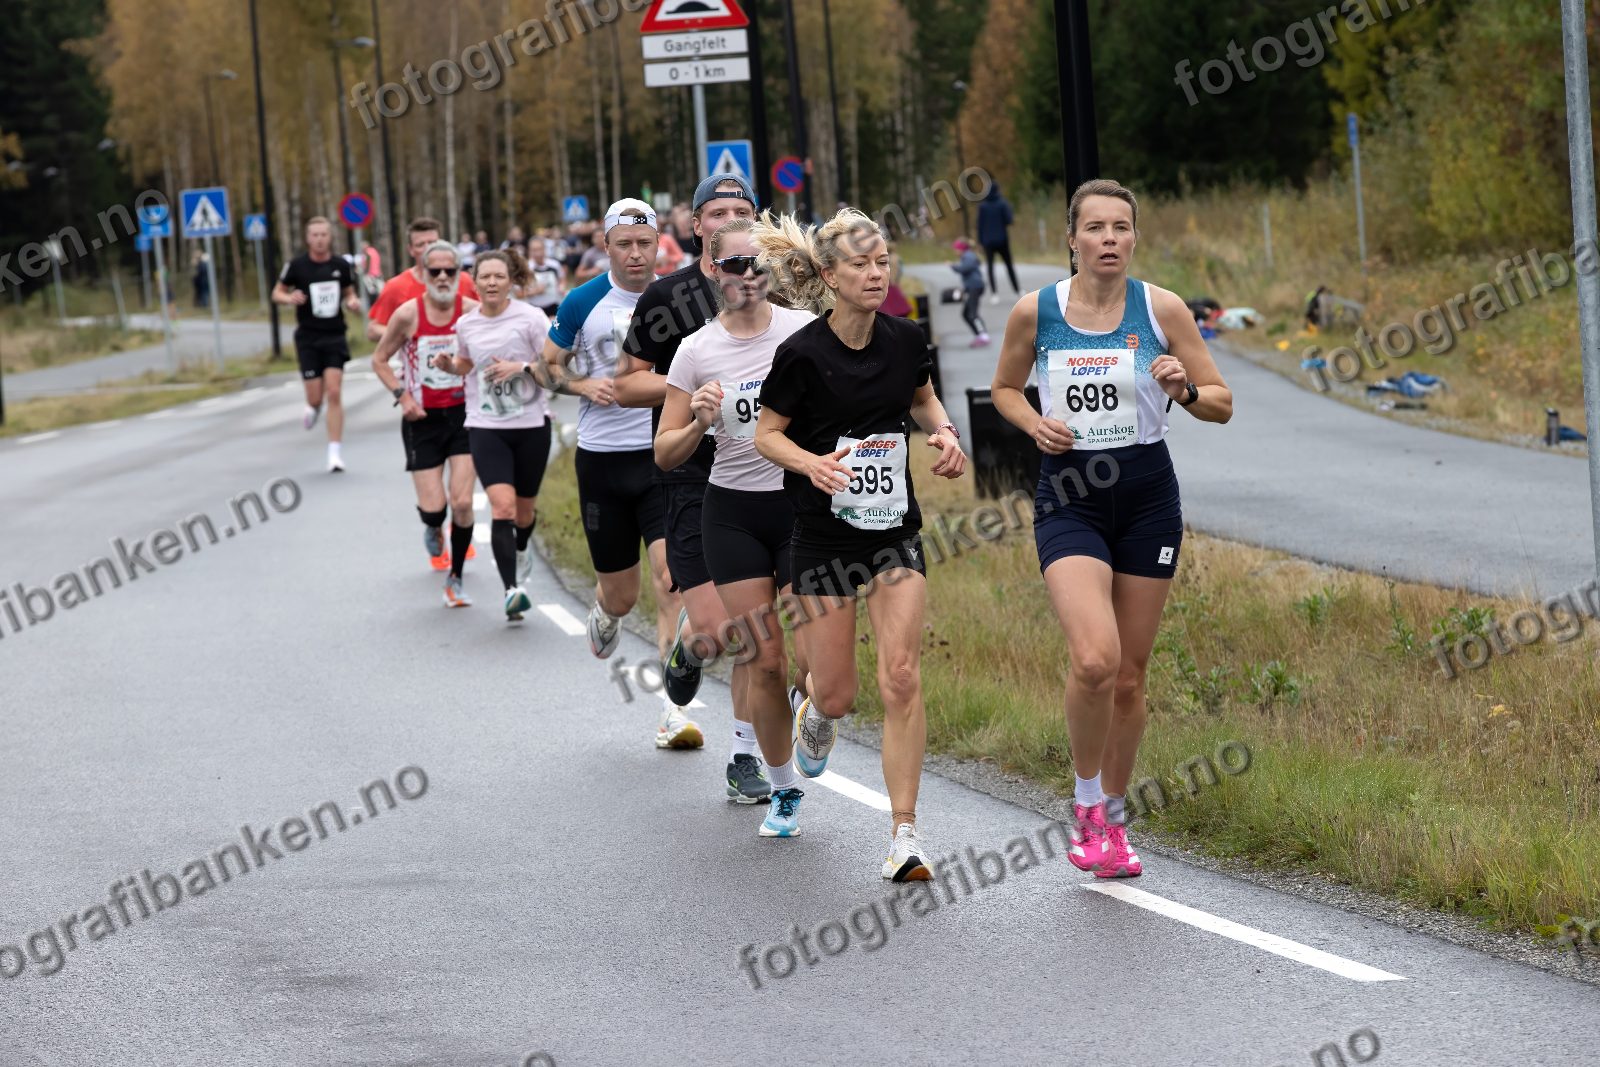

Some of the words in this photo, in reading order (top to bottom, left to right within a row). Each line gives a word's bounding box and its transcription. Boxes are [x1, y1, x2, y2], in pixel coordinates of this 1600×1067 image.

[664, 36, 727, 53] Gangfelt
[669, 67, 679, 80] 0
[703, 65, 726, 77] km
[1066, 357, 1118, 366] NORGES
[1071, 366, 1110, 376] LØPET
[1066, 383, 1119, 413] 698
[1087, 425, 1135, 437] Aurskog
[855, 449, 889, 457] LØPET
[849, 464, 894, 495] 595
